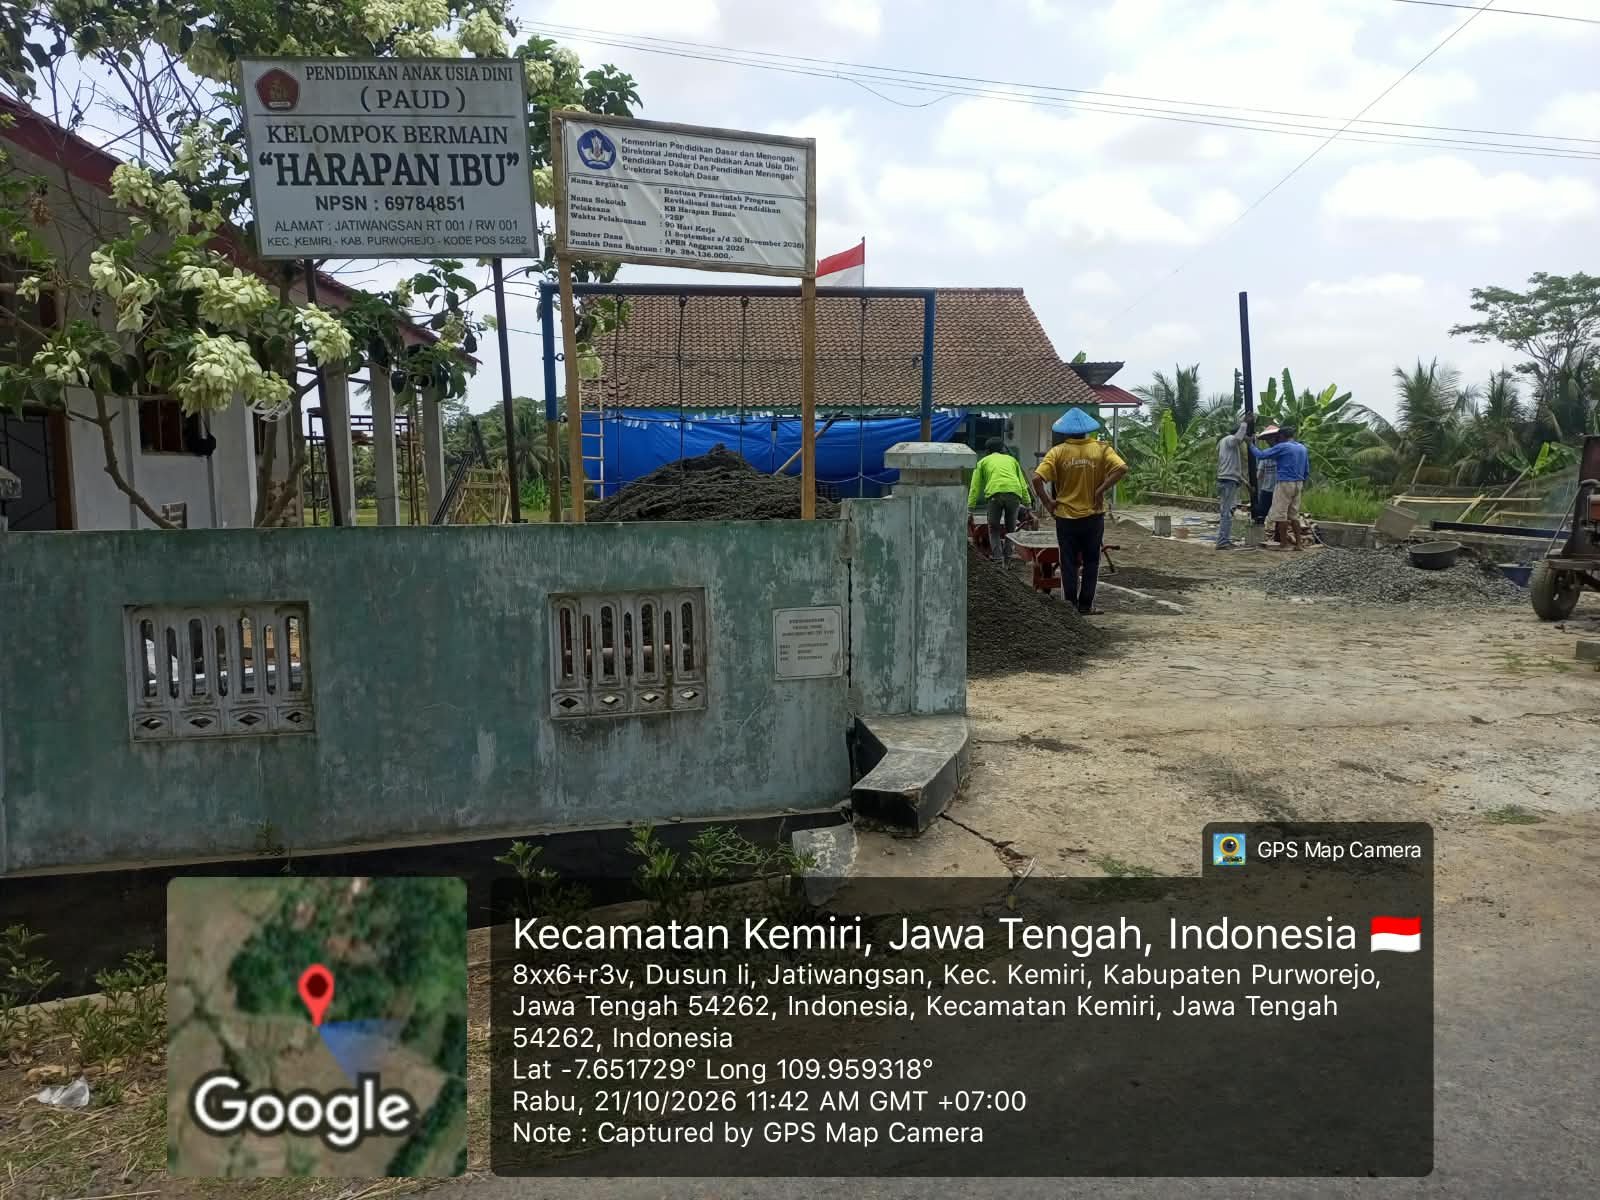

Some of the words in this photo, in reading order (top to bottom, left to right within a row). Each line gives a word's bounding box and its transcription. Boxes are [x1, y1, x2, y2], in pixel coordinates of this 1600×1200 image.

[306, 65, 398, 81] PENDIDIKAN
[402, 66, 442, 81] ANAK
[446, 67, 478, 81] USIA
[481, 67, 513, 81] DINI
[378, 89, 450, 109] PAUD
[266, 125, 398, 144] KELOMPOK
[403, 125, 508, 144] BERMAIN
[621, 137, 668, 148] Kementrian
[670, 141, 713, 154] Pendidikan
[716, 147, 737, 157] Dasar
[740, 149, 755, 158] dan
[756, 151, 795, 163] Menengah
[621, 146, 661, 156] Direktorat
[663, 151, 697, 161] Jenderal
[700, 155, 741, 166] Pendidikan
[744, 159, 765, 168] Anak
[765, 161, 782, 171] Usia
[784, 163, 799, 172] Dini
[259, 152, 439, 187] “HARAPAN
[447, 152, 520, 187] IBU”
[622, 155, 666, 166] Pendidikan
[669, 160, 692, 169] Dasar
[693, 162, 709, 171] Dan
[711, 164, 754, 176] Pendidikan
[756, 169, 794, 181] Menengah
[623, 164, 661, 175] Direktorat
[663, 168, 695, 179] Sekolah
[697, 171, 719, 181] Dasar
[570, 177, 593, 185] Nama
[595, 179, 629, 190] kegiatan
[664, 188, 696, 197] Bantuan
[699, 191, 742, 202] Pemerintah
[744, 196, 776, 206] Program
[316, 195, 367, 211] NPSN
[385, 196, 465, 211] 69784851
[570, 195, 593, 203] Nama
[595, 197, 626, 207] Sekolah
[664, 205, 676, 213] KB
[678, 207, 710, 217] Harapan
[570, 203, 611, 213] Pelaksana
[664, 197, 709, 207] Revitalisasi
[740, 204, 781, 214] Pendidikan
[275, 221, 324, 232] ALAMAT
[335, 220, 423, 232] JATIWANGSAN
[426, 220, 442, 231] RT
[445, 220, 465, 231] 001
[476, 220, 496, 231] RW
[499, 220, 518, 231] 001
[570, 212, 596, 221] Waktu
[599, 214, 647, 226] Pelaksanaan
[677, 223, 693, 231] Hari
[695, 225, 716, 235] Kerja
[267, 237, 291, 247] KEC.
[295, 237, 332, 247] KEMIRI
[341, 237, 364, 246] KAB.
[367, 236, 434, 246] PURWOREJO
[443, 236, 472, 245] KODE
[475, 236, 496, 245] POS
[570, 230, 601, 238] Sumber
[603, 232, 623, 240] Dana
[688, 241, 724, 251] Anggaran
[570, 239, 600, 247] Jumlah
[603, 241, 623, 249] Dana
[625, 243, 658, 253] Bantuan
